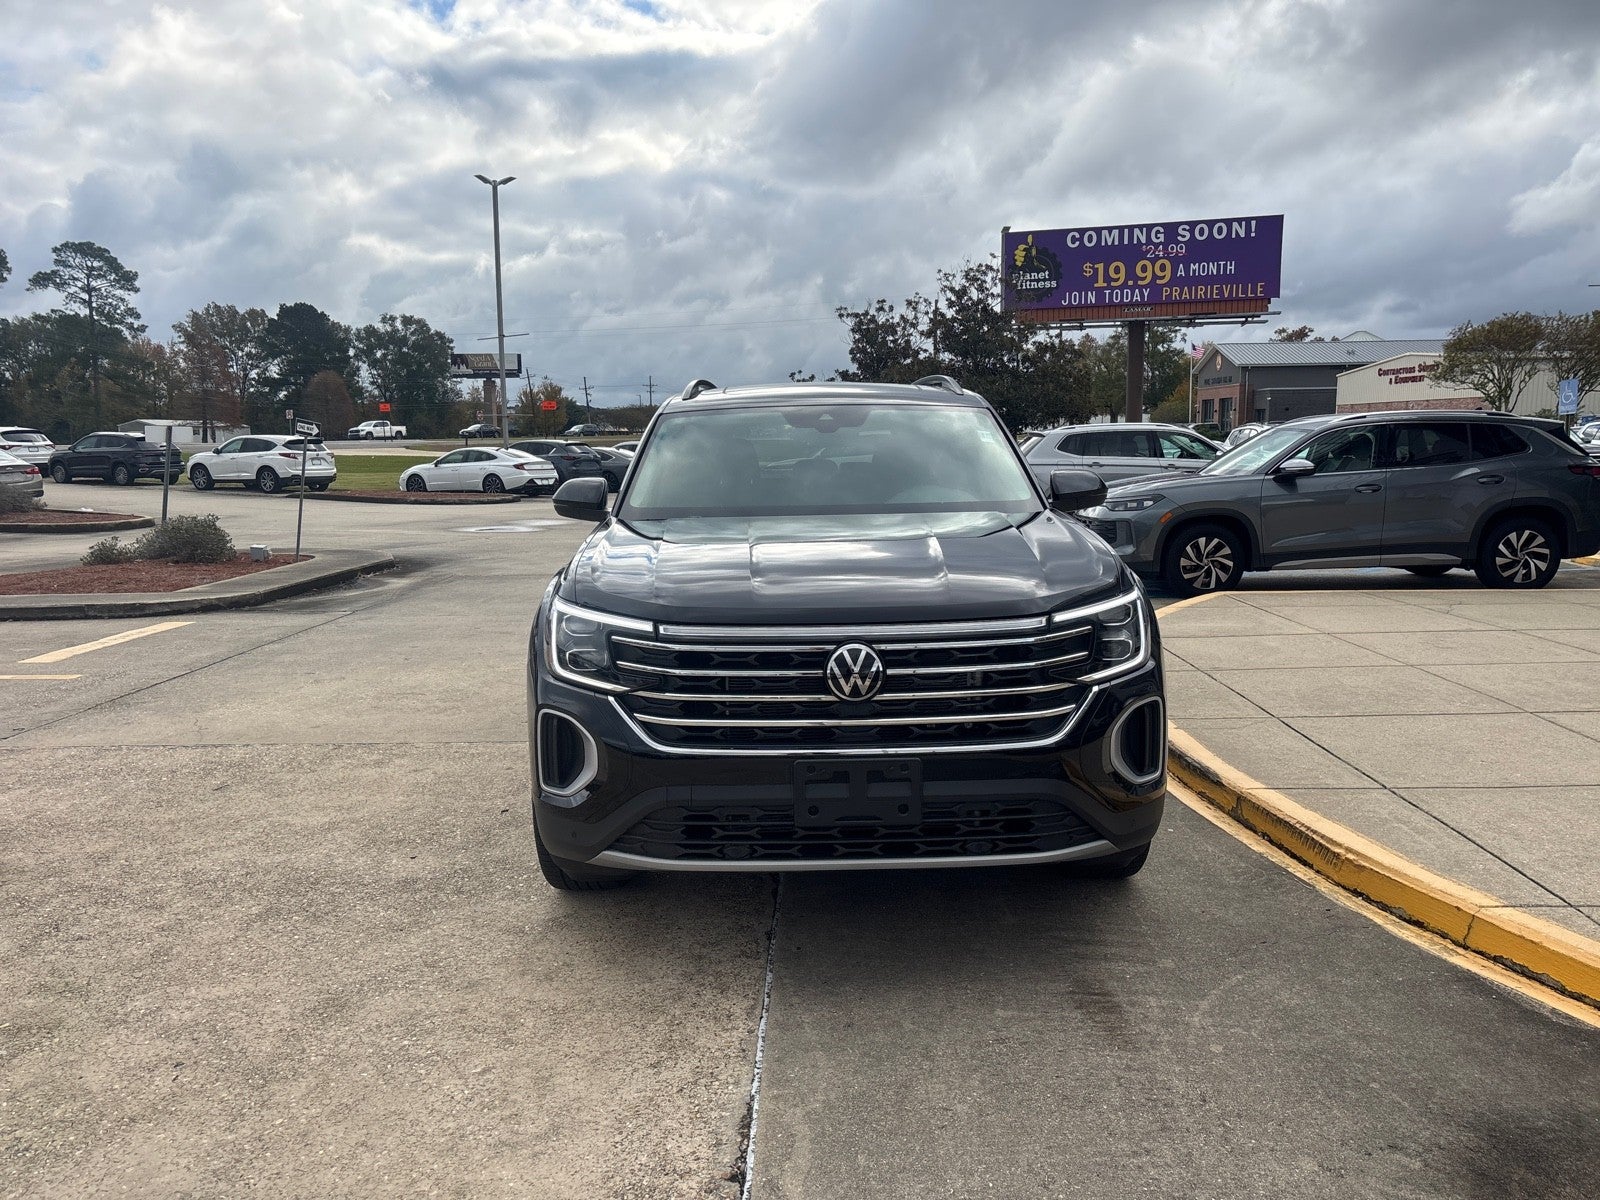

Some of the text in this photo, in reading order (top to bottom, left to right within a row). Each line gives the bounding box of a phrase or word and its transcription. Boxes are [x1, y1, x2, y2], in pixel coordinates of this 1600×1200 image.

[1067, 220, 1257, 248] COMING SOON!
[1142, 243, 1186, 258] $24.99
[1012, 270, 1049, 283] planet
[1083, 258, 1236, 288] $19.99 A MONTH
[1016, 280, 1057, 290] fitness
[1062, 282, 1265, 306] JOIN TODAY PRAIRIEVILLE
